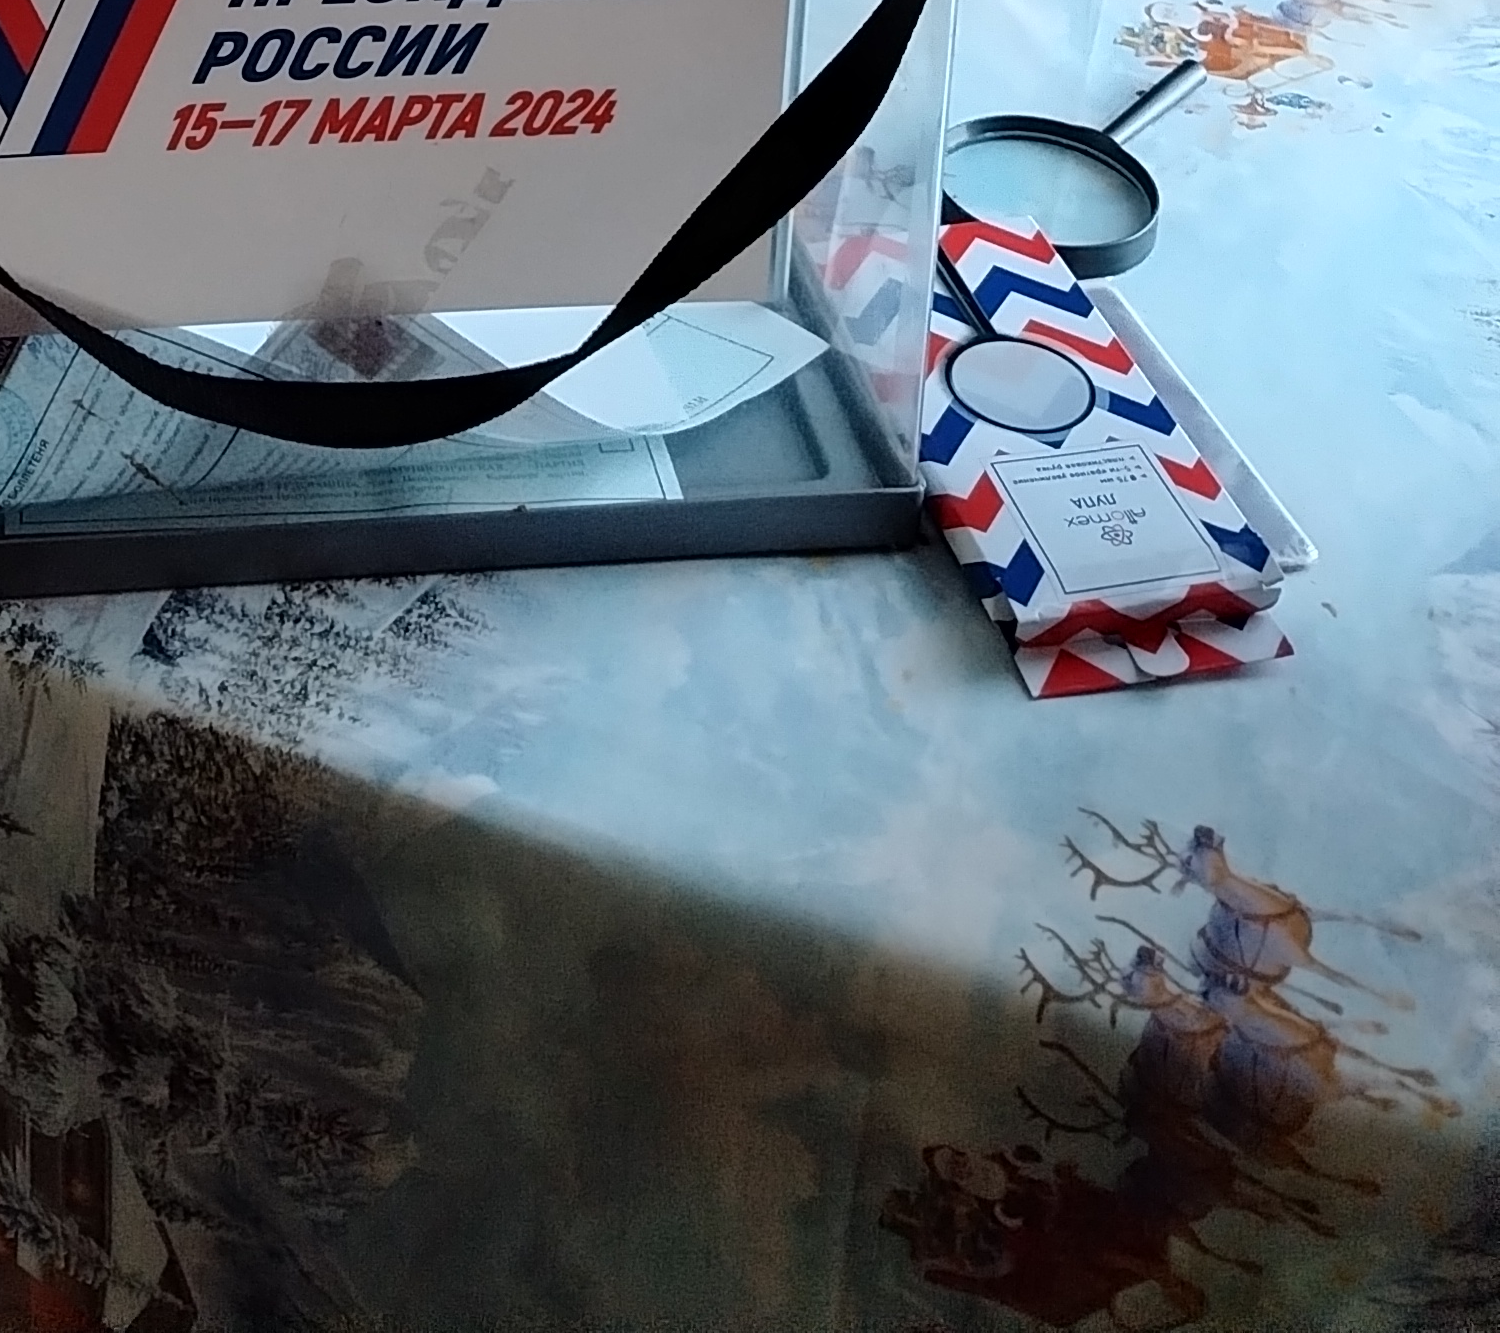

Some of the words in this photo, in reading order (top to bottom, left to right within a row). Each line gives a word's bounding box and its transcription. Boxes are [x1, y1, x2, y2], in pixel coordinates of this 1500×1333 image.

[192, 23, 489, 84] РОССИИ
[309, 93, 485, 144] МАРТА
[488, 88, 617, 139] 2024
[1069, 493, 1117, 509] ЛУПА
